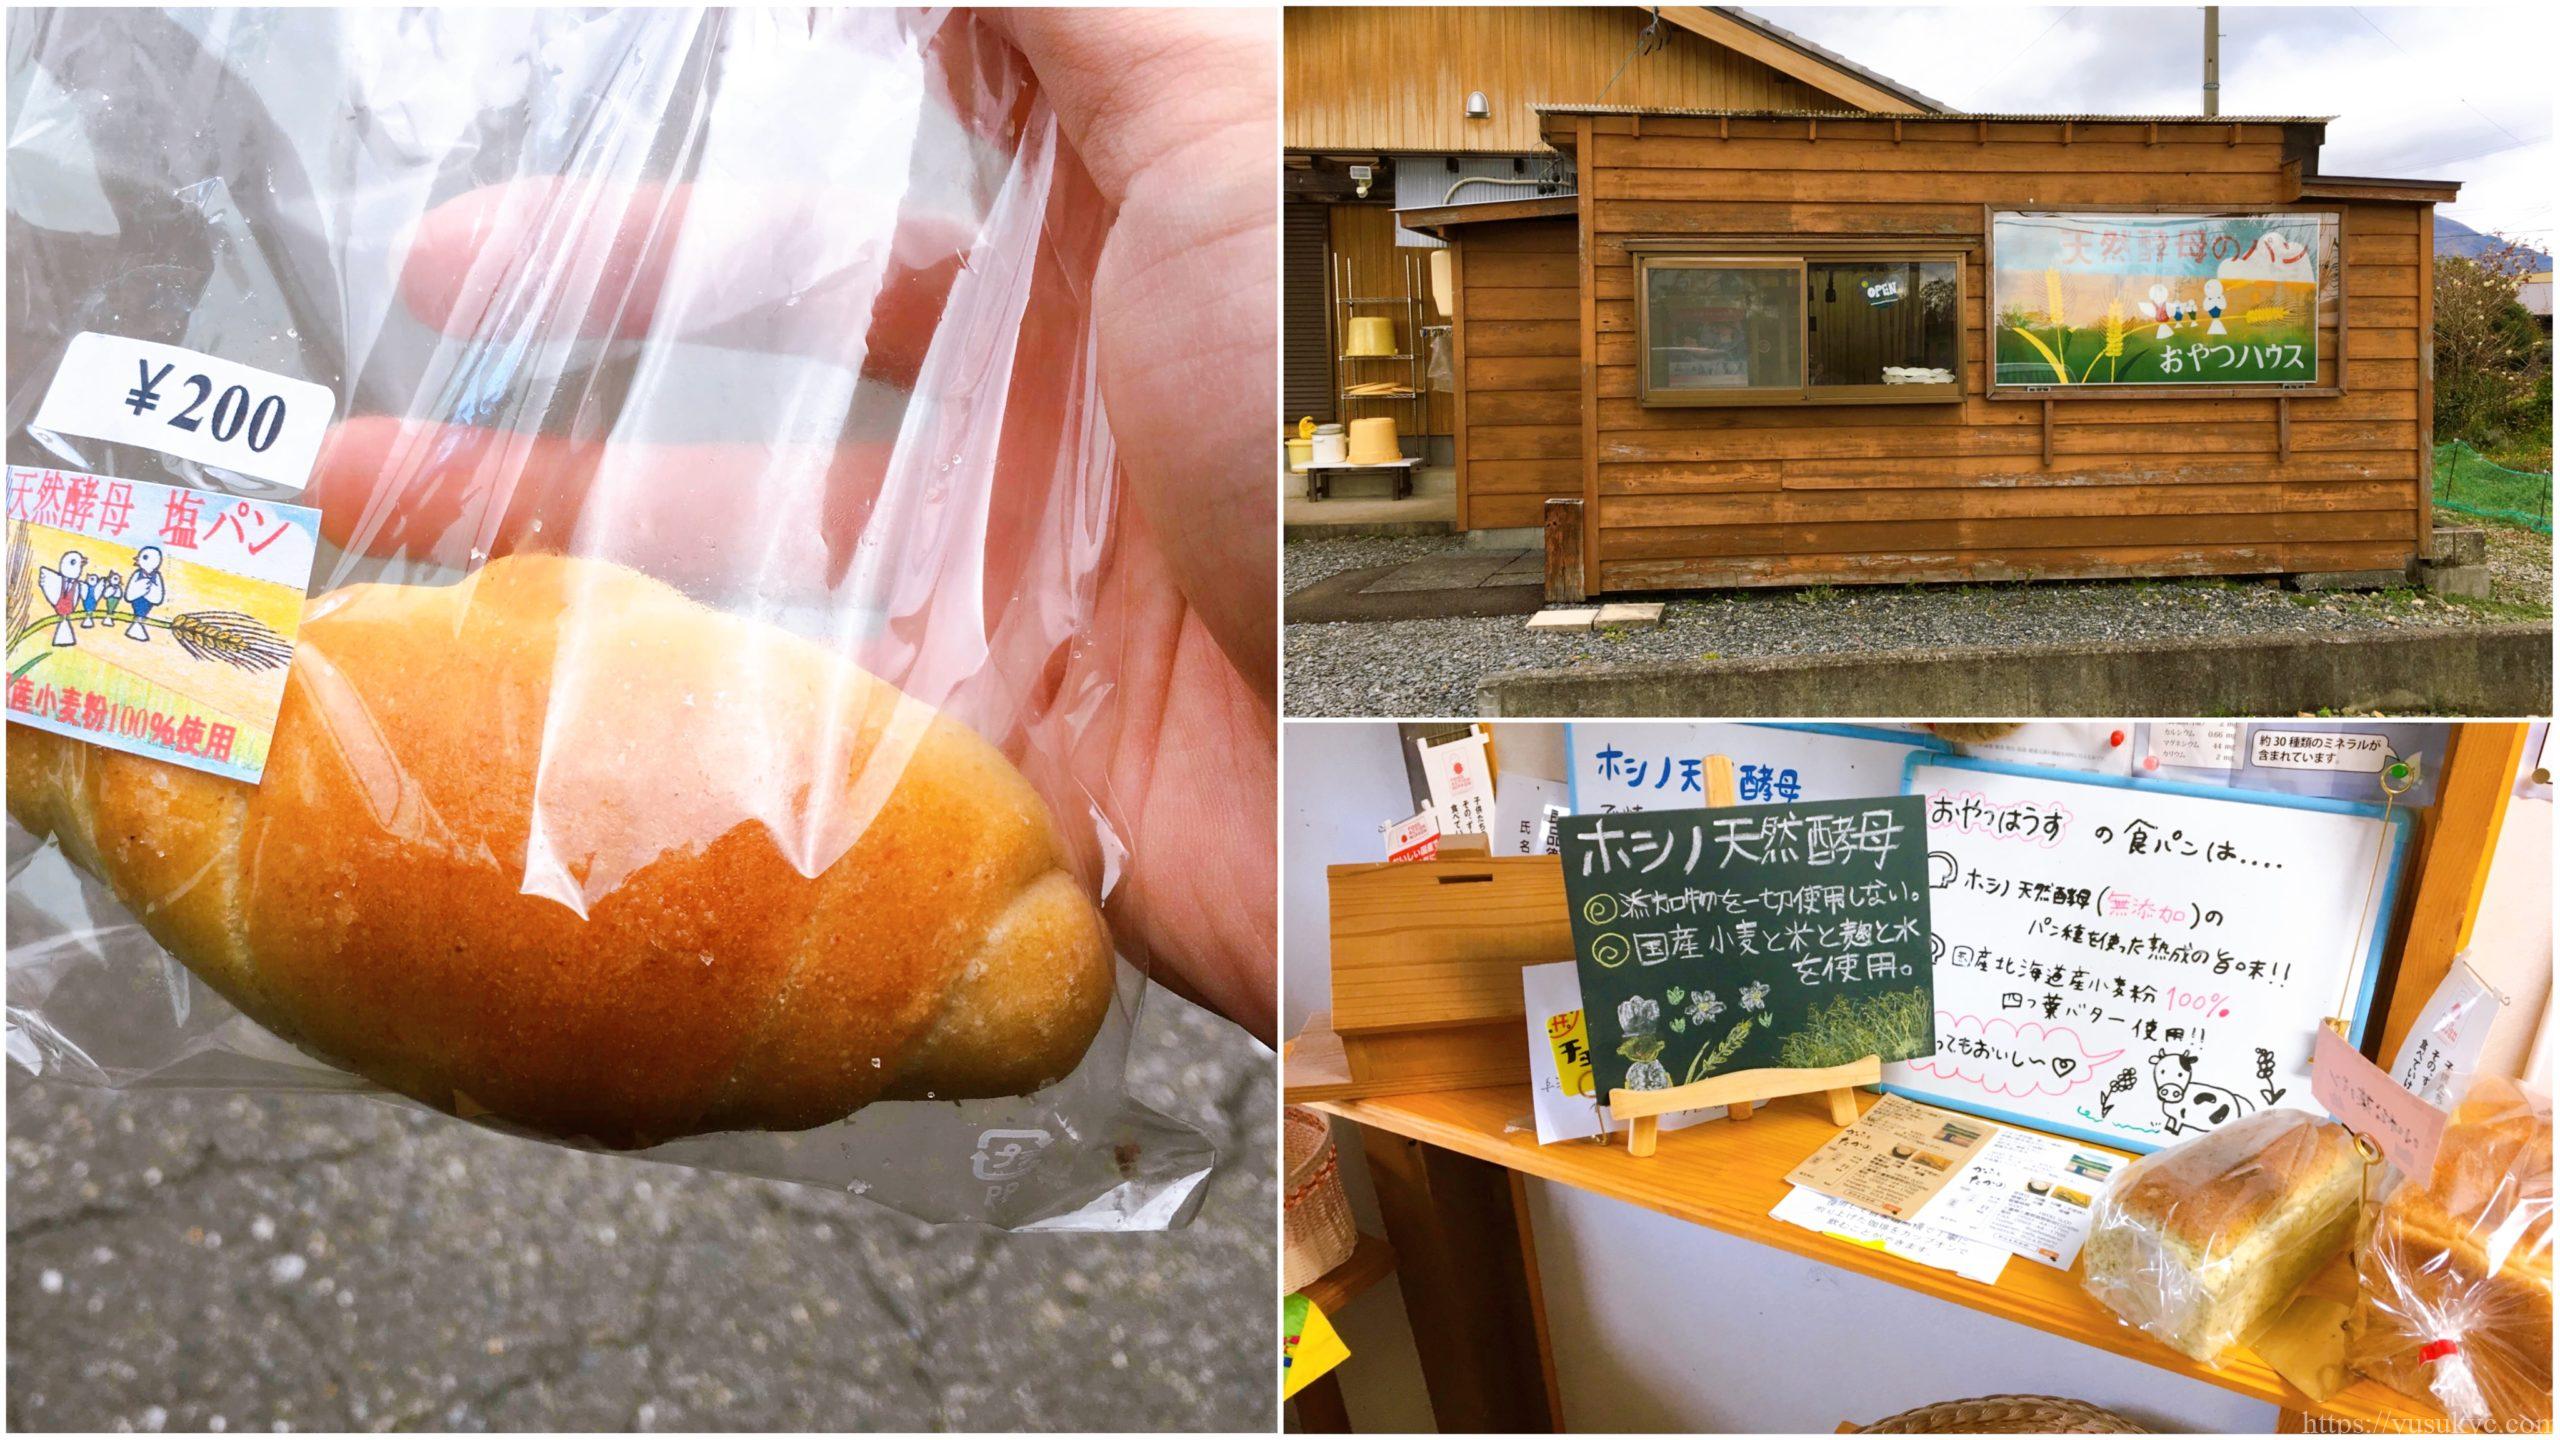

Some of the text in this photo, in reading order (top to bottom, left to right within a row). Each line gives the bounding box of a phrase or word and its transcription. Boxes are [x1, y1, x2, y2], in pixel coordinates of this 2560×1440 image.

[2061, 227, 2309, 265] 天然酵母のパン
[1867, 281, 1897, 298] OPEN
[2159, 343, 2305, 375] おやつハウス
[125, 358, 287, 453] ¥200
[6, 470, 292, 555] 天然酵母 塩パン
[6, 672, 237, 763] 産小麦粉100%使用
[1595, 743, 1802, 803] ホシノ天酵母
[1577, 808, 1904, 876] ホシノ天然酵母
[1620, 880, 1920, 920] 添加物を一切使用しない。
[1791, 951, 1913, 986] を使用。
